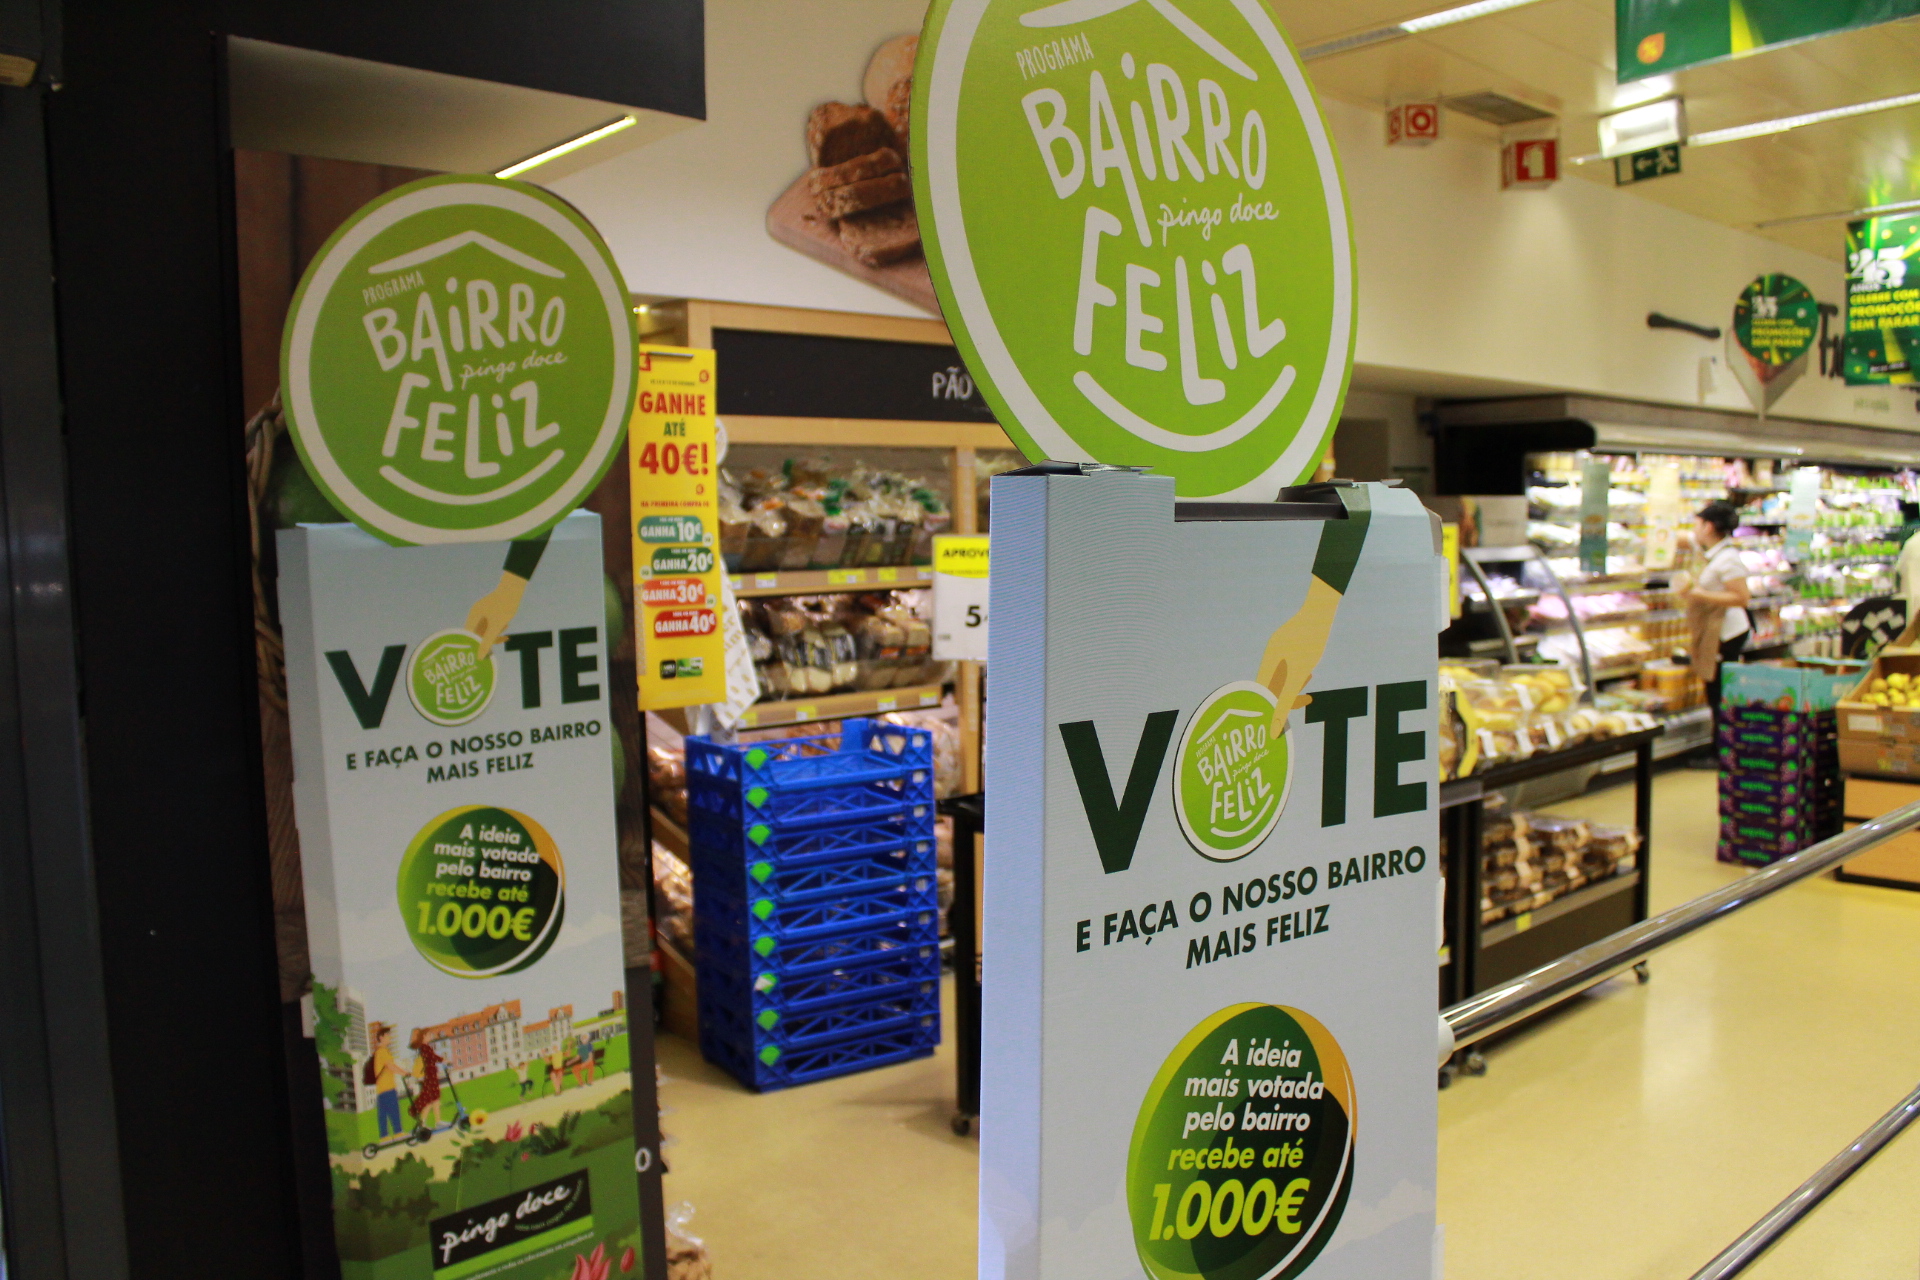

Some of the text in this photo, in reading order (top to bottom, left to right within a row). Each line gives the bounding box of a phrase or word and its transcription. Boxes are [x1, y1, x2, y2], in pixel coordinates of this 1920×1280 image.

[1016, 31, 1094, 80] PROGRAMA
[1157, 193, 1279, 247] pingo doce
[362, 270, 424, 306] PROGRAMA
[459, 350, 567, 390] pingo doce
[932, 366, 973, 399] PÃO
[639, 391, 706, 416] GANHE
[663, 418, 686, 437] ATÉ
[639, 442, 709, 476] 40€!
[641, 521, 702, 542] GANHA 10€
[653, 552, 714, 572] GANHA 20€
[642, 583, 704, 603] GANHA 30€
[655, 620, 689, 633] GANHA
[689, 613, 716, 633] 40€
[346, 720, 601, 770] E FAÇA O NOSSO BAIRRO
[426, 752, 534, 784] MAIS FELIZ
[460, 824, 521, 845] A ideia
[434, 841, 540, 865] mais votada
[435, 859, 531, 882] pelo bairro
[426, 878, 529, 903] recebe até
[1076, 845, 1426, 953] E FAÇA O NOSSO BAIRRO
[416, 901, 536, 941] 1.000€
[1186, 904, 1330, 969] MAIS FELIZ
[1220, 1038, 1302, 1068] A ideia
[1184, 1069, 1324, 1100] mais votada
[1182, 1102, 1310, 1139] pelo bairro
[1167, 1137, 1303, 1171] recebe até
[439, 1211, 511, 1264] pingo
[515, 1185, 573, 1219] doce
[1149, 1178, 1310, 1241] 1.000€
